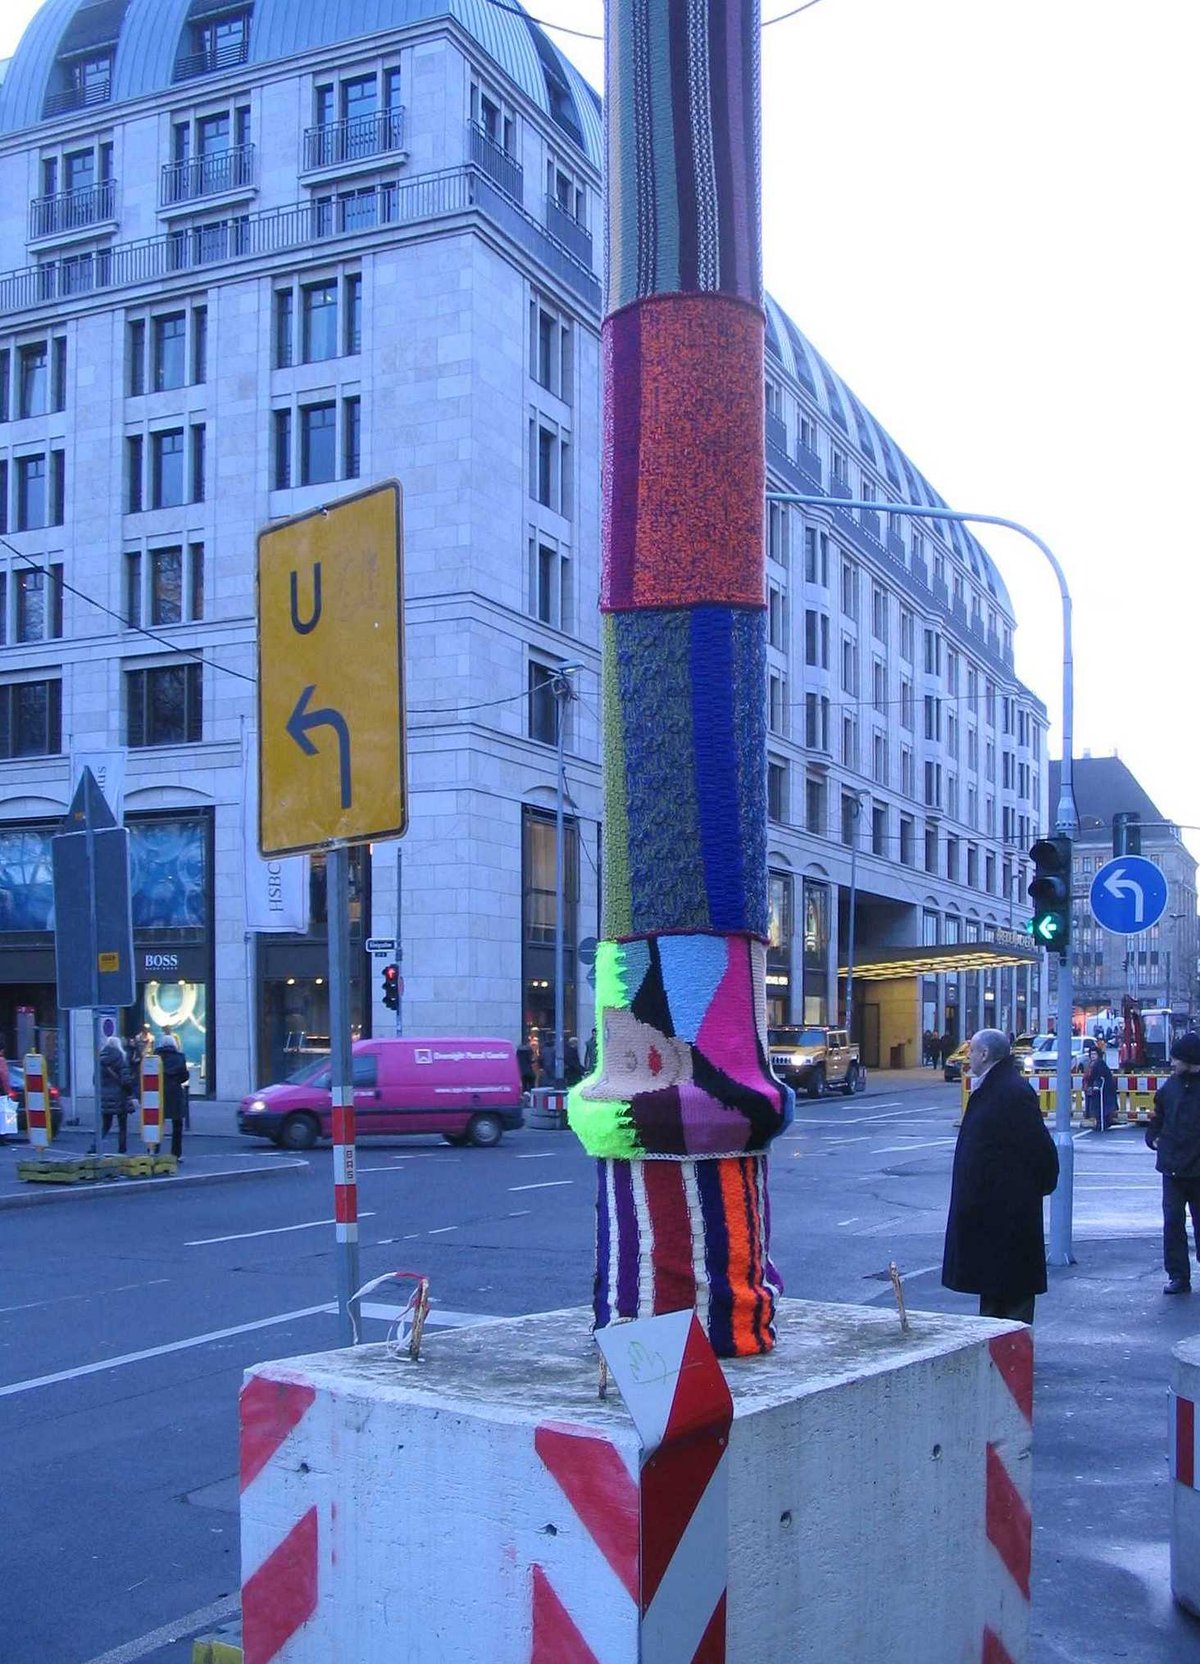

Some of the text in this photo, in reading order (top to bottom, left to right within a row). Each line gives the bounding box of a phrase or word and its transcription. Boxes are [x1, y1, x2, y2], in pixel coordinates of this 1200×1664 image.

[290, 562, 322, 635] U
[267, 861, 284, 912] HSBC
[145, 954, 178, 967] BOSS
